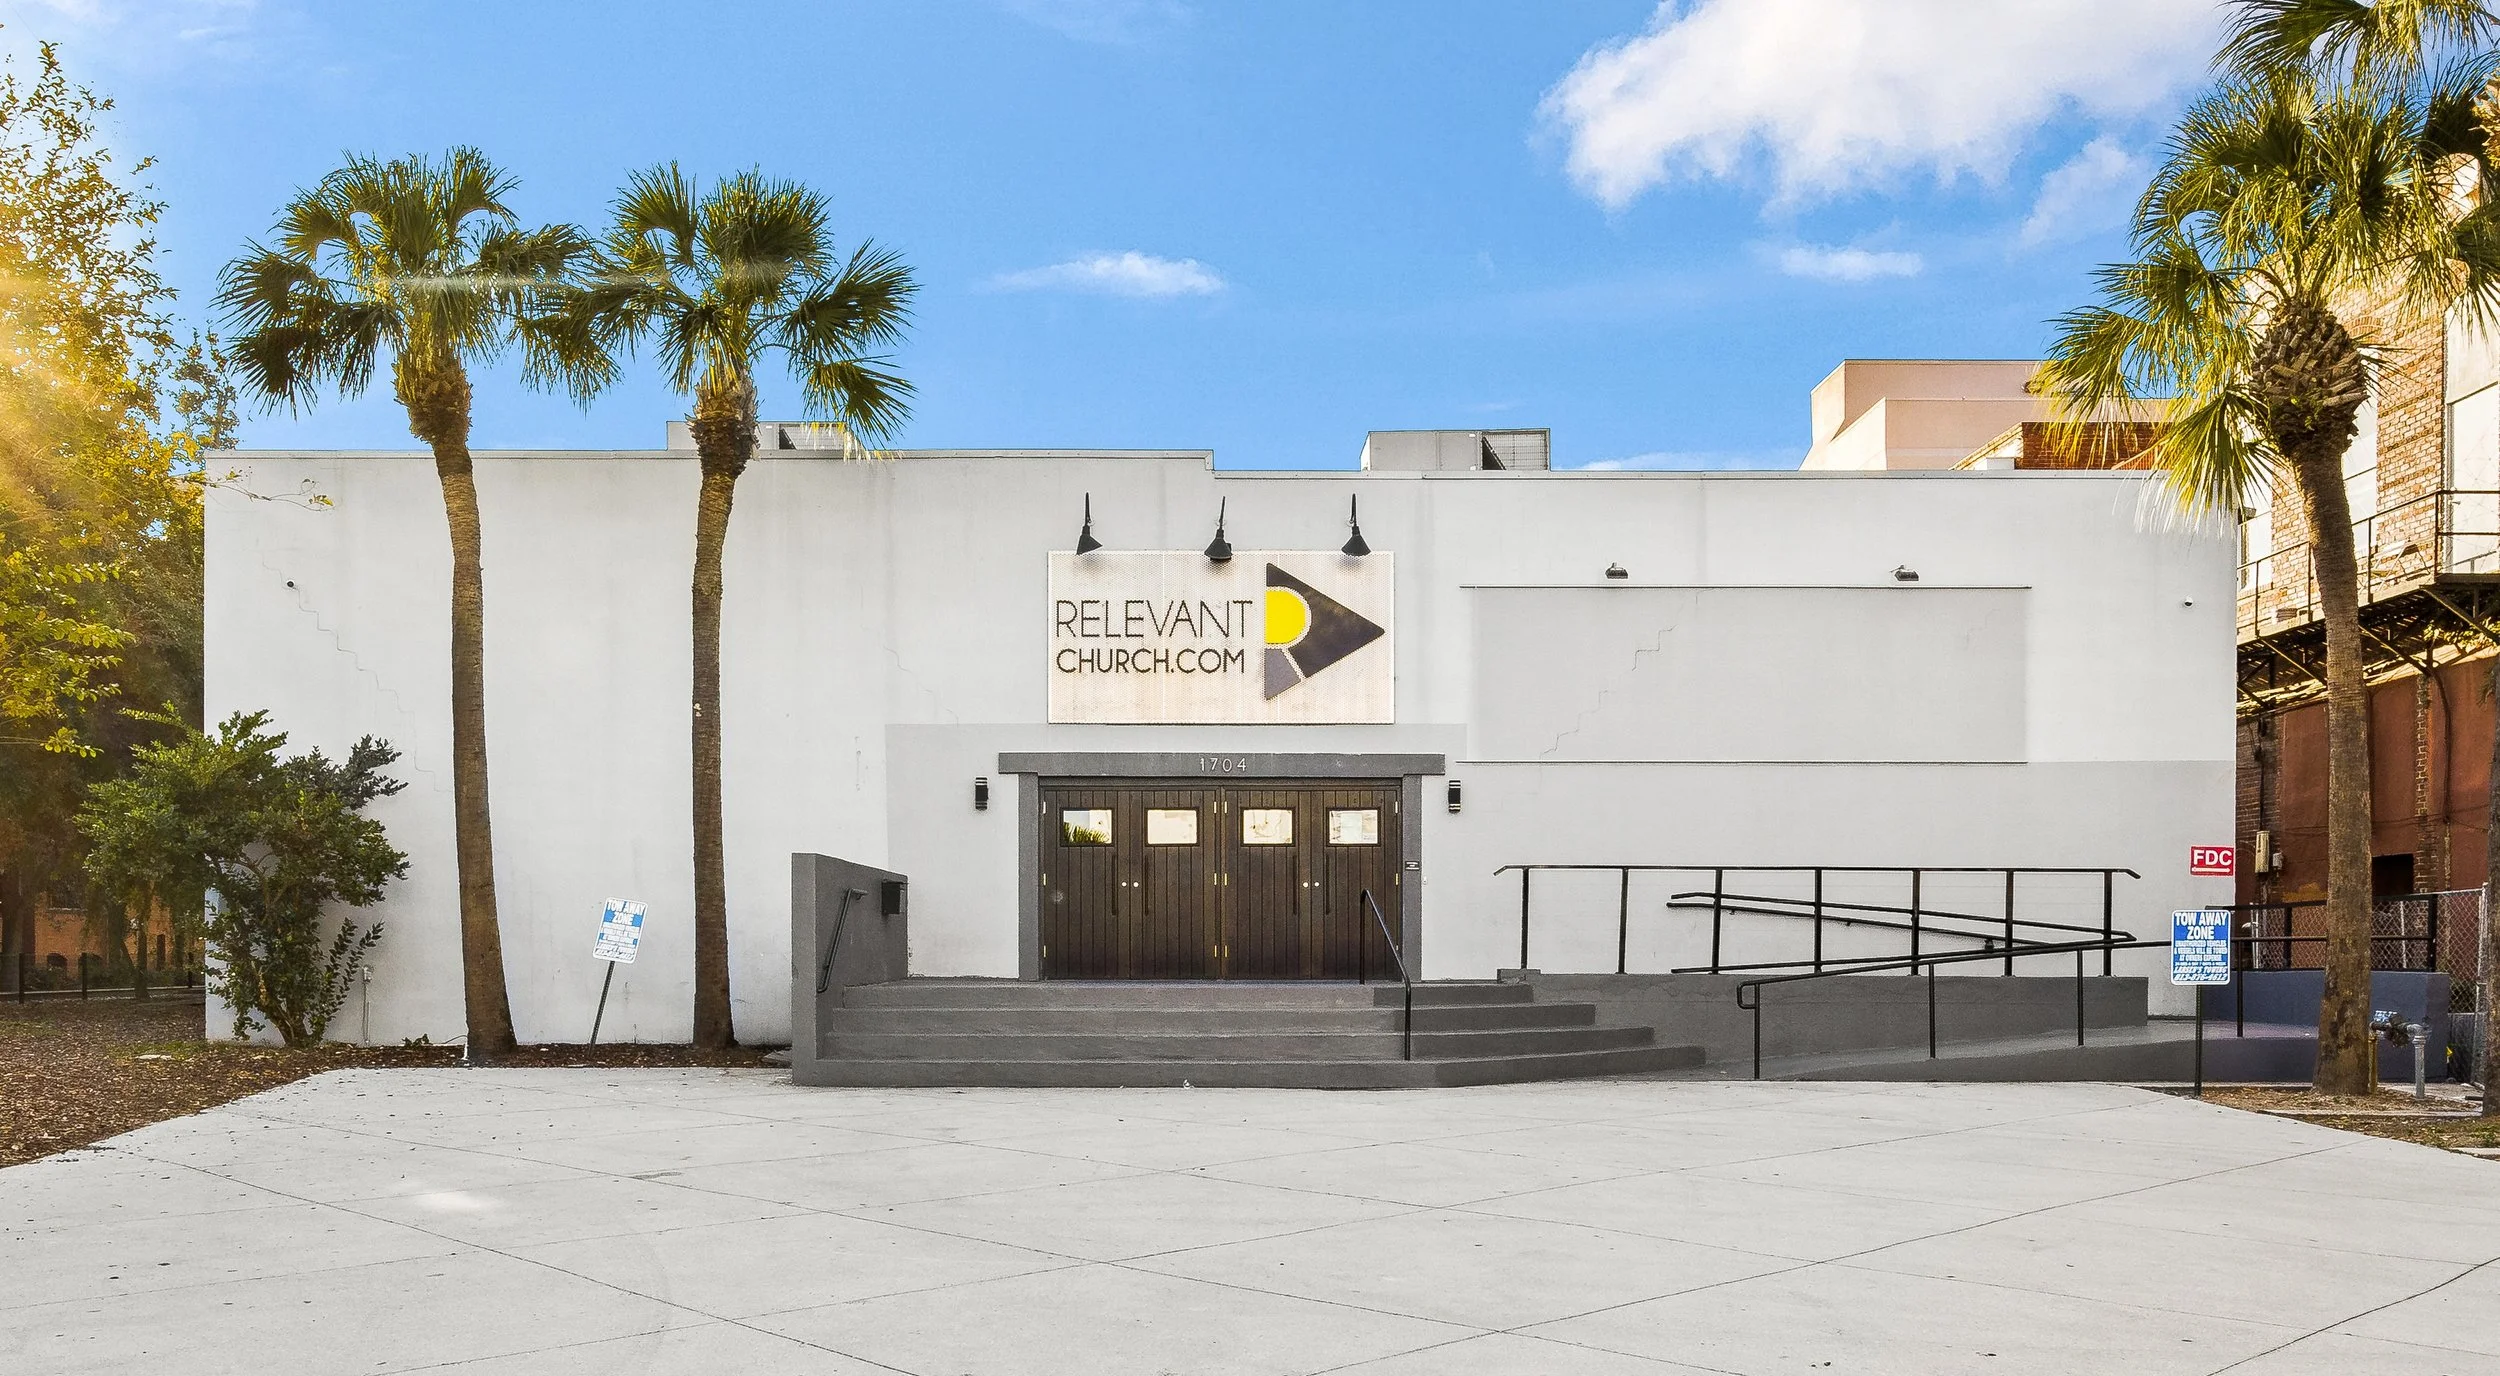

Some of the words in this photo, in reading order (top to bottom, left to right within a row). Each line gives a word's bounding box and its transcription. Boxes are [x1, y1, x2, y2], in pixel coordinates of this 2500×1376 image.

[1056, 599, 1253, 638] RELEVANT
[1056, 648, 1245, 674] CHURCH.COM
[1200, 757, 1247, 772] 1704
[2193, 849, 2232, 866] FDC
[607, 900, 625, 912] TOW
[623, 901, 646, 915] AWAY
[612, 912, 635, 926] ZONE
[2175, 912, 2197, 926] TOW
[2199, 912, 2227, 926] AWAY
[2187, 926, 2214, 940] ZONE
